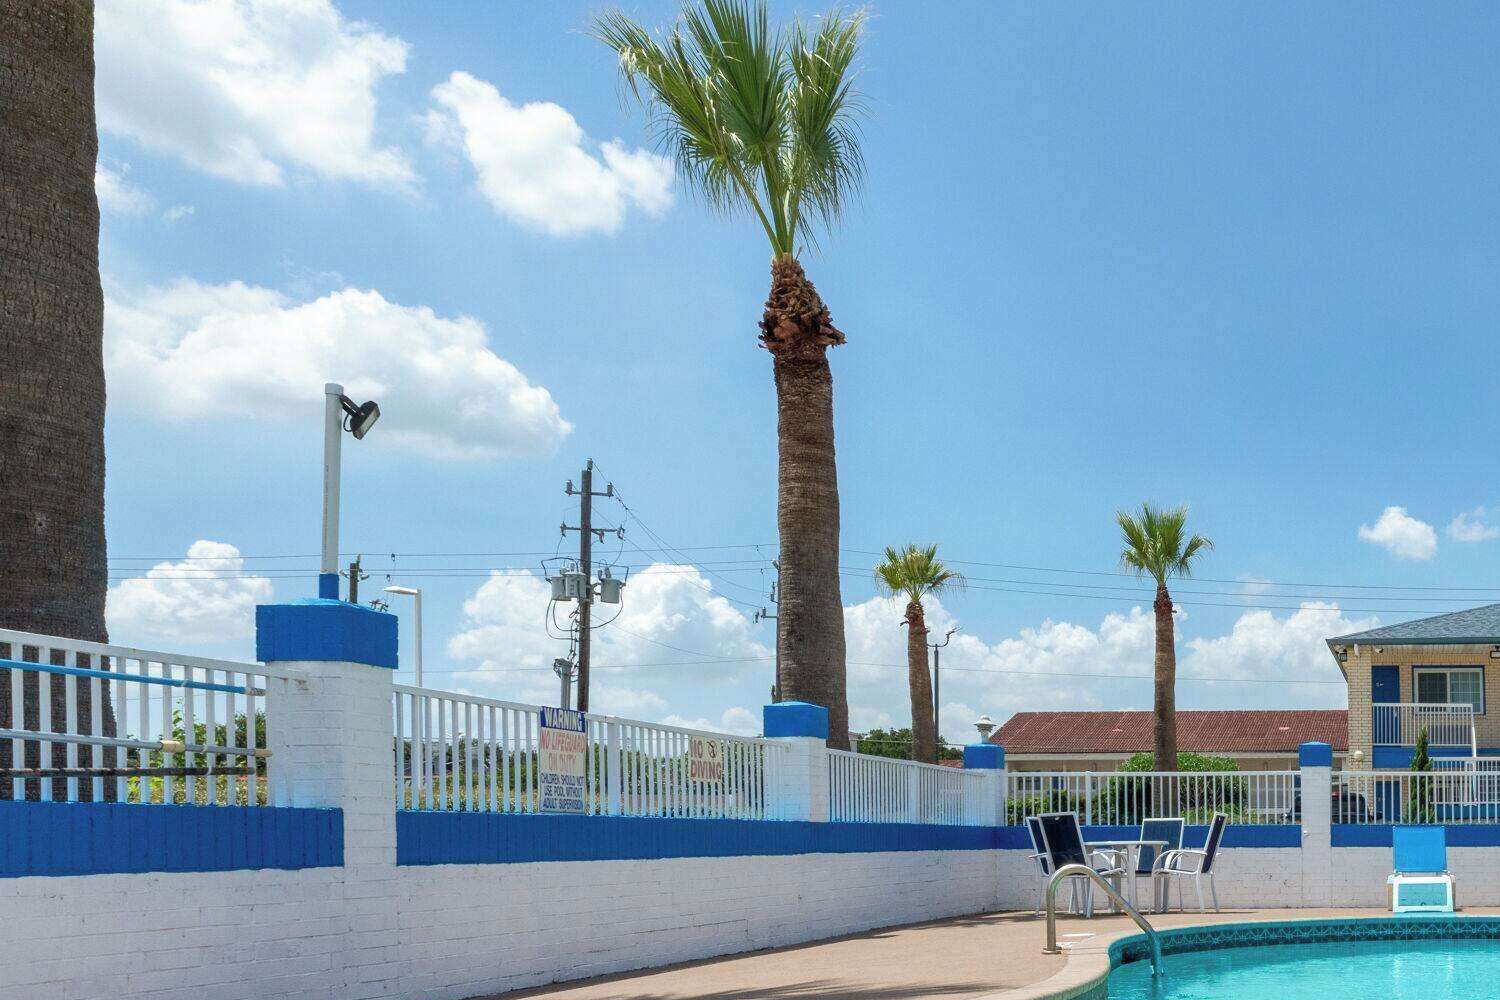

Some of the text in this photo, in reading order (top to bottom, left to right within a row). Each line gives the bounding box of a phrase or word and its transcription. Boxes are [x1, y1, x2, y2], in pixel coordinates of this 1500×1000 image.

[544, 707, 583, 731] WARNING
[541, 731, 585, 752] NO LIFEGUARD
[690, 739, 703, 758] NO
[549, 752, 576, 771] ON DUTY
[691, 760, 721, 779] DIVING
[541, 773, 560, 785] CHILDREN
[561, 775, 575, 786] SHOULD
[544, 785, 583, 798] USE POOL WITHOUT
[543, 798, 583, 810] ADULT SUPERVISION
